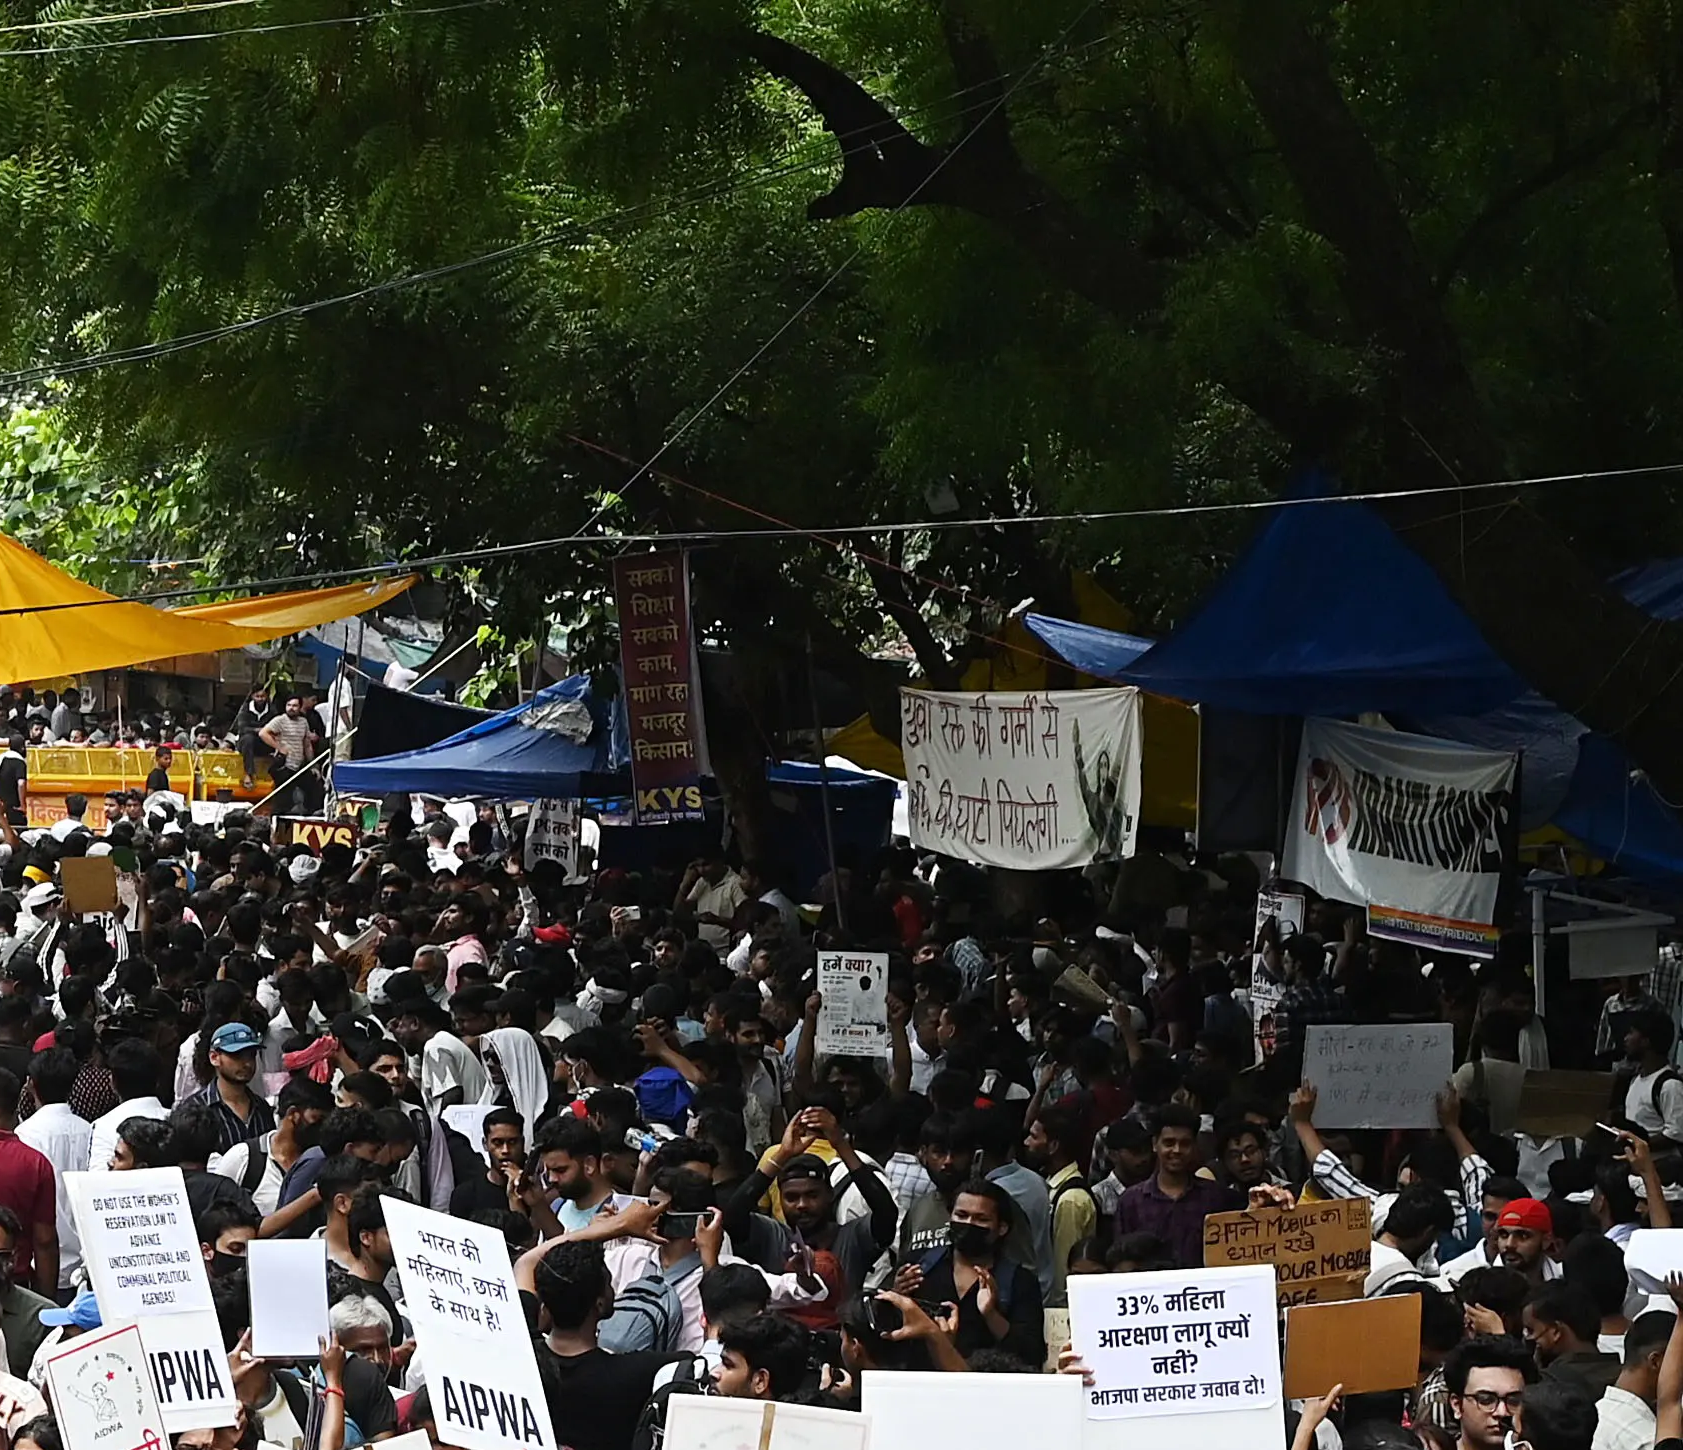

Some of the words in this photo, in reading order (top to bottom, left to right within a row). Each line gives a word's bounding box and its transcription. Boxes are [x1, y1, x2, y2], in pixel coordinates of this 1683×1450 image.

[626, 564, 674, 587] सबको
[630, 595, 675, 616] शिक्षा
[631, 618, 680, 645] सबको
[665, 682, 689, 701] रहा
[638, 712, 687, 737] मजदूर
[969, 693, 992, 759] की
[1041, 692, 1059, 759] से
[637, 785, 703, 811] KYS
[118, 1195, 133, 1209] USE
[133, 1194, 146, 1207] THE
[104, 1214, 153, 1230] RESERVATION
[153, 1212, 168, 1226] LAW
[168, 1211, 177, 1225] TO
[1205, 1211, 1260, 1246] अपने
[1320, 1209, 1342, 1224] का
[129, 1232, 162, 1248] ADVANCE
[417, 1229, 457, 1258] भारत
[460, 1237, 481, 1264] की
[175, 1250, 191, 1263] AND
[117, 1273, 156, 1289] COMMUNAL
[156, 1270, 191, 1286] POLITICAL
[141, 1290, 175, 1306] AGENDAS!
[1116, 1292, 1160, 1318] 33%
[1163, 1286, 1226, 1313] महिला
[428, 1290, 447, 1316] के
[449, 1300, 482, 1326] साथ
[483, 1303, 502, 1332] है!
[1098, 1320, 1169, 1350] आरक्षण
[1172, 1318, 1216, 1348] लागू
[1215, 1312, 1252, 1340] क्यों
[149, 1348, 225, 1404] IPWA
[1150, 1352, 1199, 1377] नहीं?
[1090, 1385, 1139, 1407] भाजपा
[1142, 1382, 1196, 1403] सरकार
[1198, 1379, 1241, 1400] जवाब
[1243, 1376, 1266, 1396] दो!
[442, 1375, 544, 1447] AIPWA
[94, 1421, 124, 1440] AIDWA
